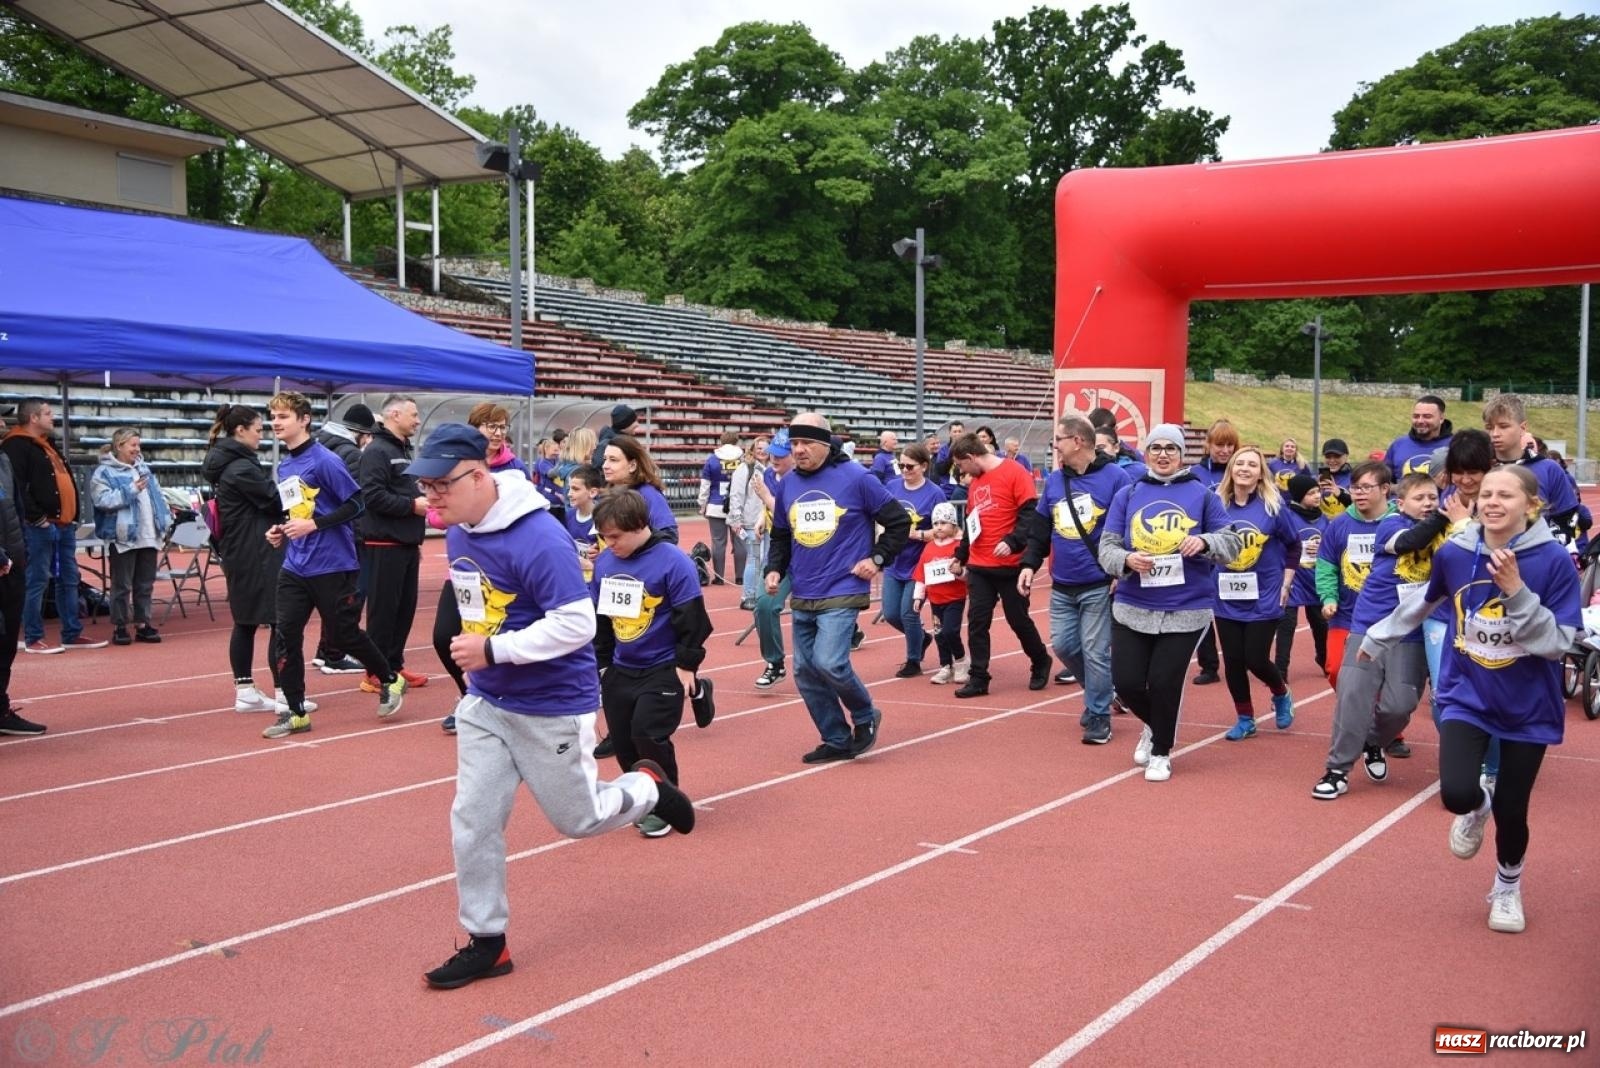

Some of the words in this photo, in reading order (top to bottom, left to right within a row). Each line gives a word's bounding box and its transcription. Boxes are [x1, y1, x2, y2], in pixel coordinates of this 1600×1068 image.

[804, 511, 826, 522] 033
[931, 567, 947, 577] 132
[1149, 564, 1172, 577] 077
[1229, 582, 1248, 592] 129
[611, 591, 632, 606] 158
[1476, 630, 1513, 647] 093
